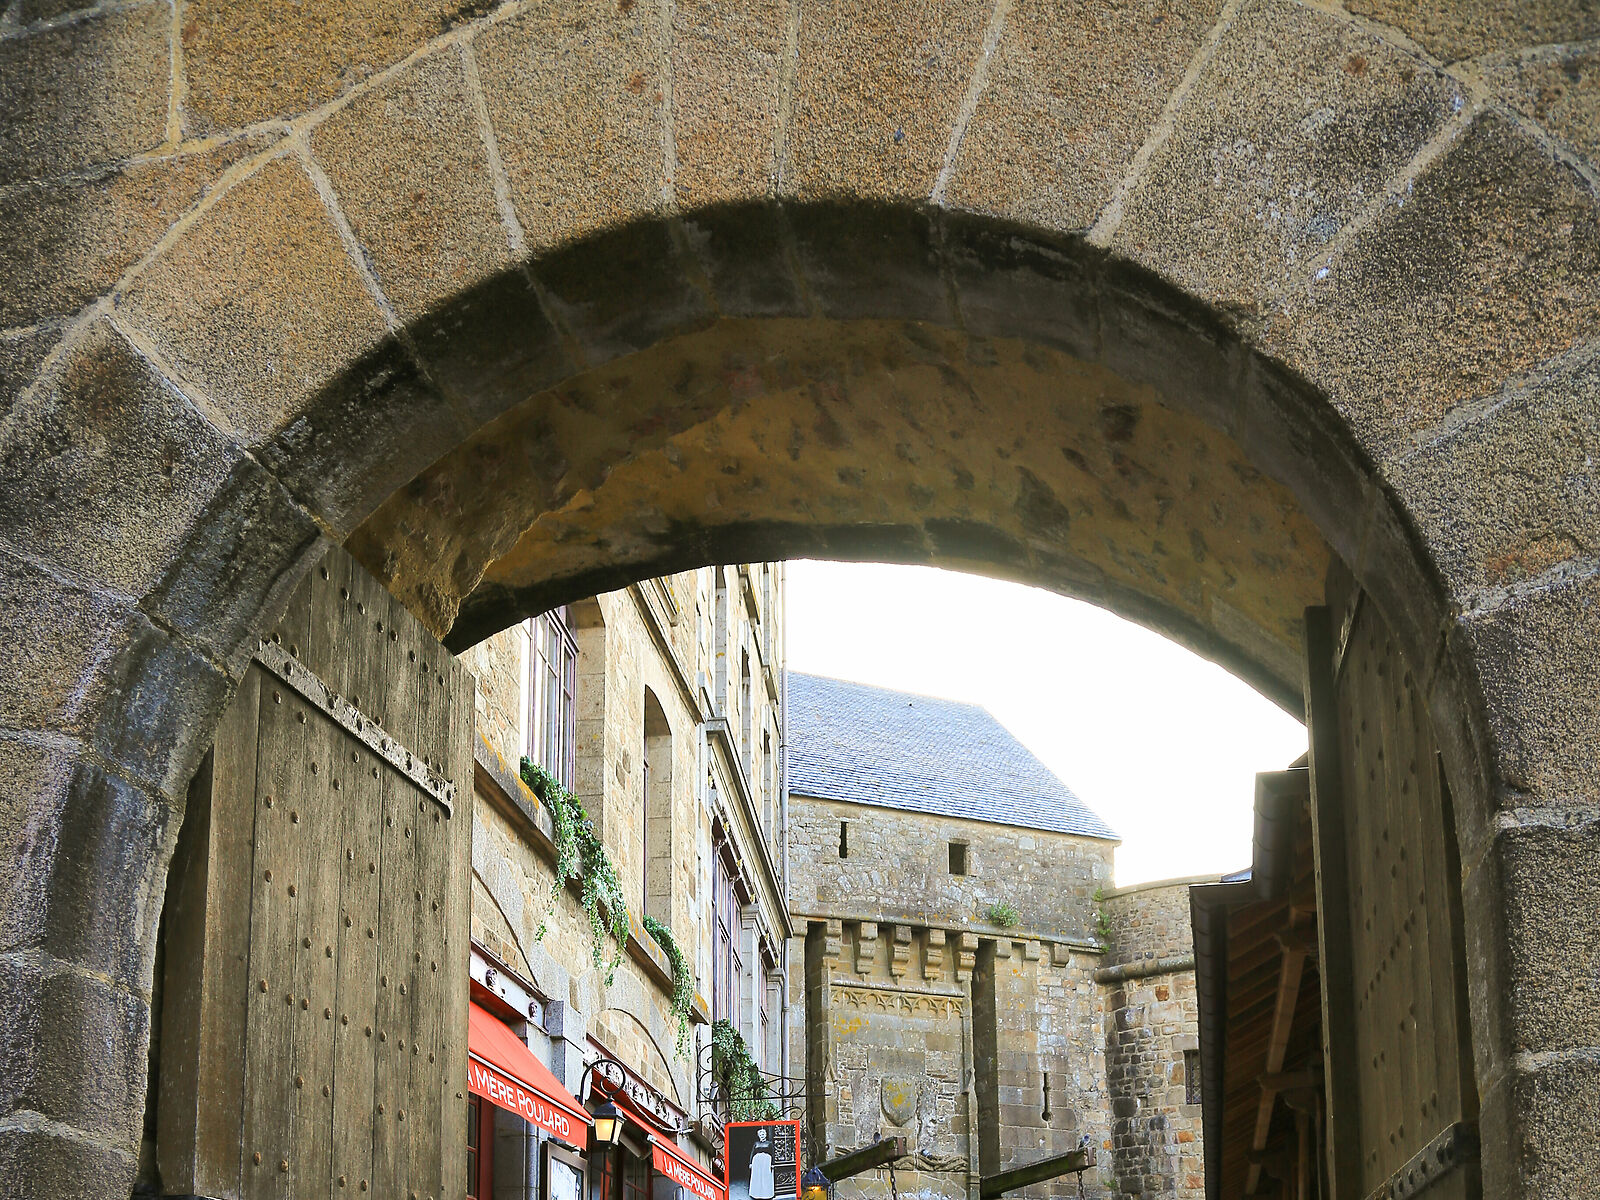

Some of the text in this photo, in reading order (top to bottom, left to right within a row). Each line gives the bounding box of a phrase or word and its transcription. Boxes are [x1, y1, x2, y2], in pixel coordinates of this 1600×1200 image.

[474, 1064, 517, 1108] MÈRE
[517, 1088, 570, 1137] POULARD
[663, 1155, 674, 1177] LA
